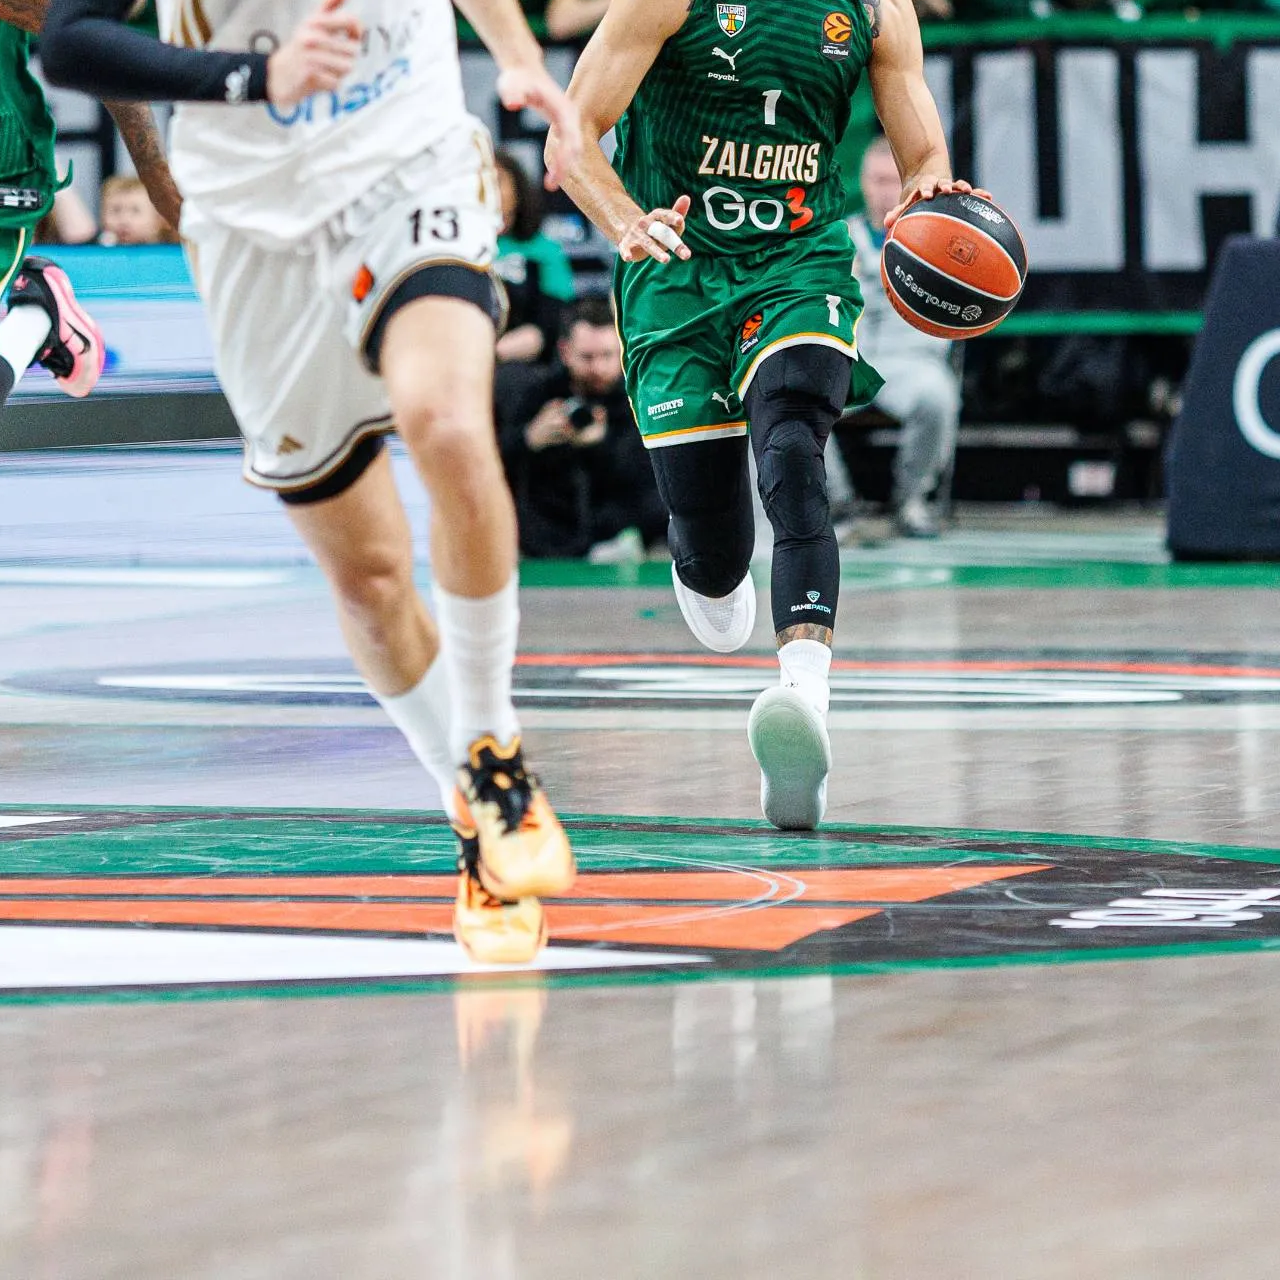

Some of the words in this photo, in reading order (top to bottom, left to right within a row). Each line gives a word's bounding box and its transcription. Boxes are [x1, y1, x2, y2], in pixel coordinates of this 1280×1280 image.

[762, 89, 782, 126] 1
[409, 206, 459, 246] 13
[702, 186, 814, 231] Go3
[825, 294, 841, 328] 1
[790, 603, 832, 615] GAMEPATCH
